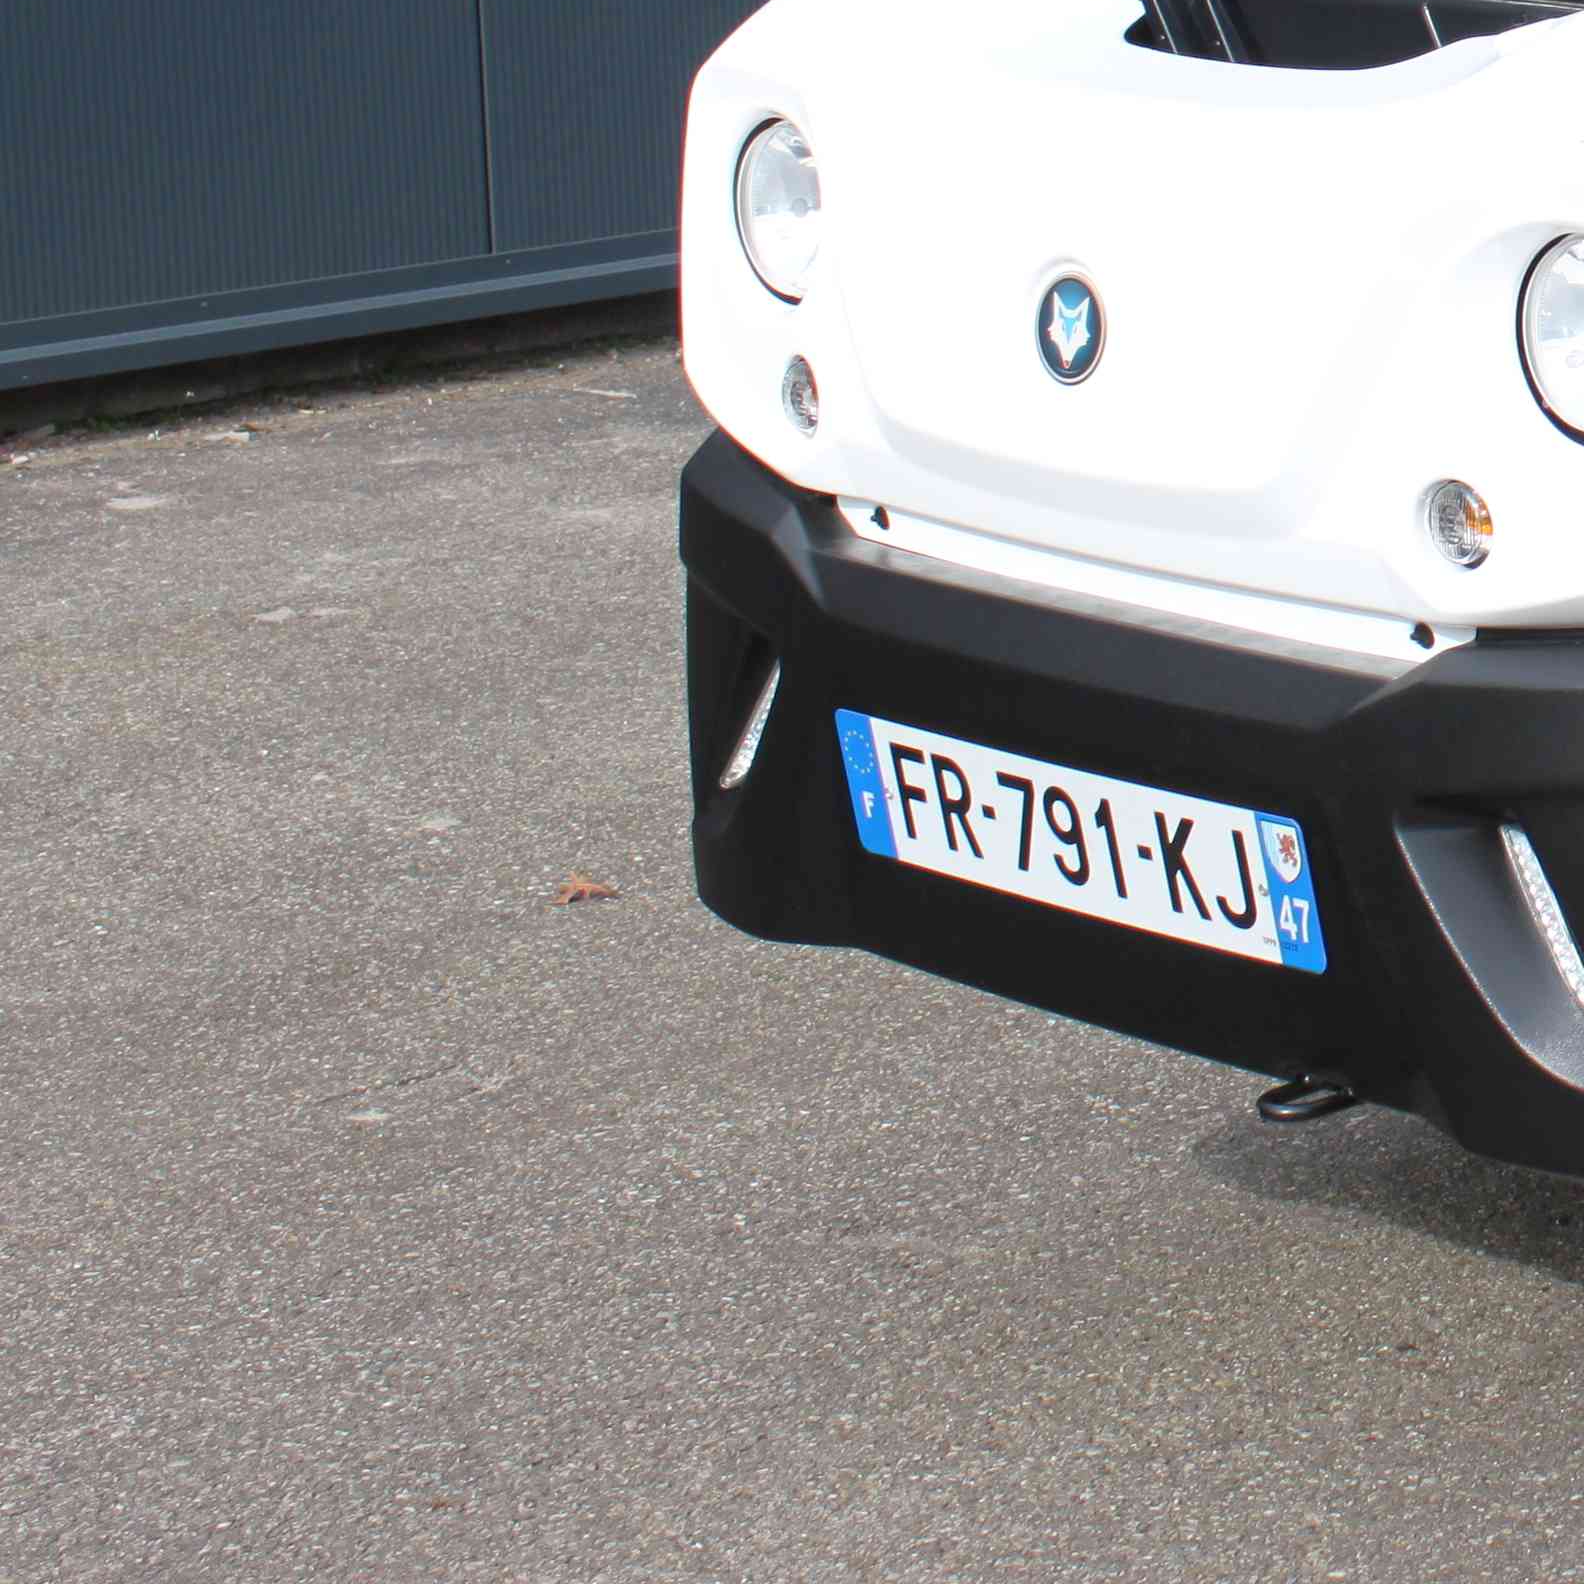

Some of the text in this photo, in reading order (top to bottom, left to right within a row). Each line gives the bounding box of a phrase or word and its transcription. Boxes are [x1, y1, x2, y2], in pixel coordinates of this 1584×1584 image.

[862, 790, 876, 818] F
[889, 741, 1258, 930] FR-791-KJ
[1279, 894, 1310, 944] 47
